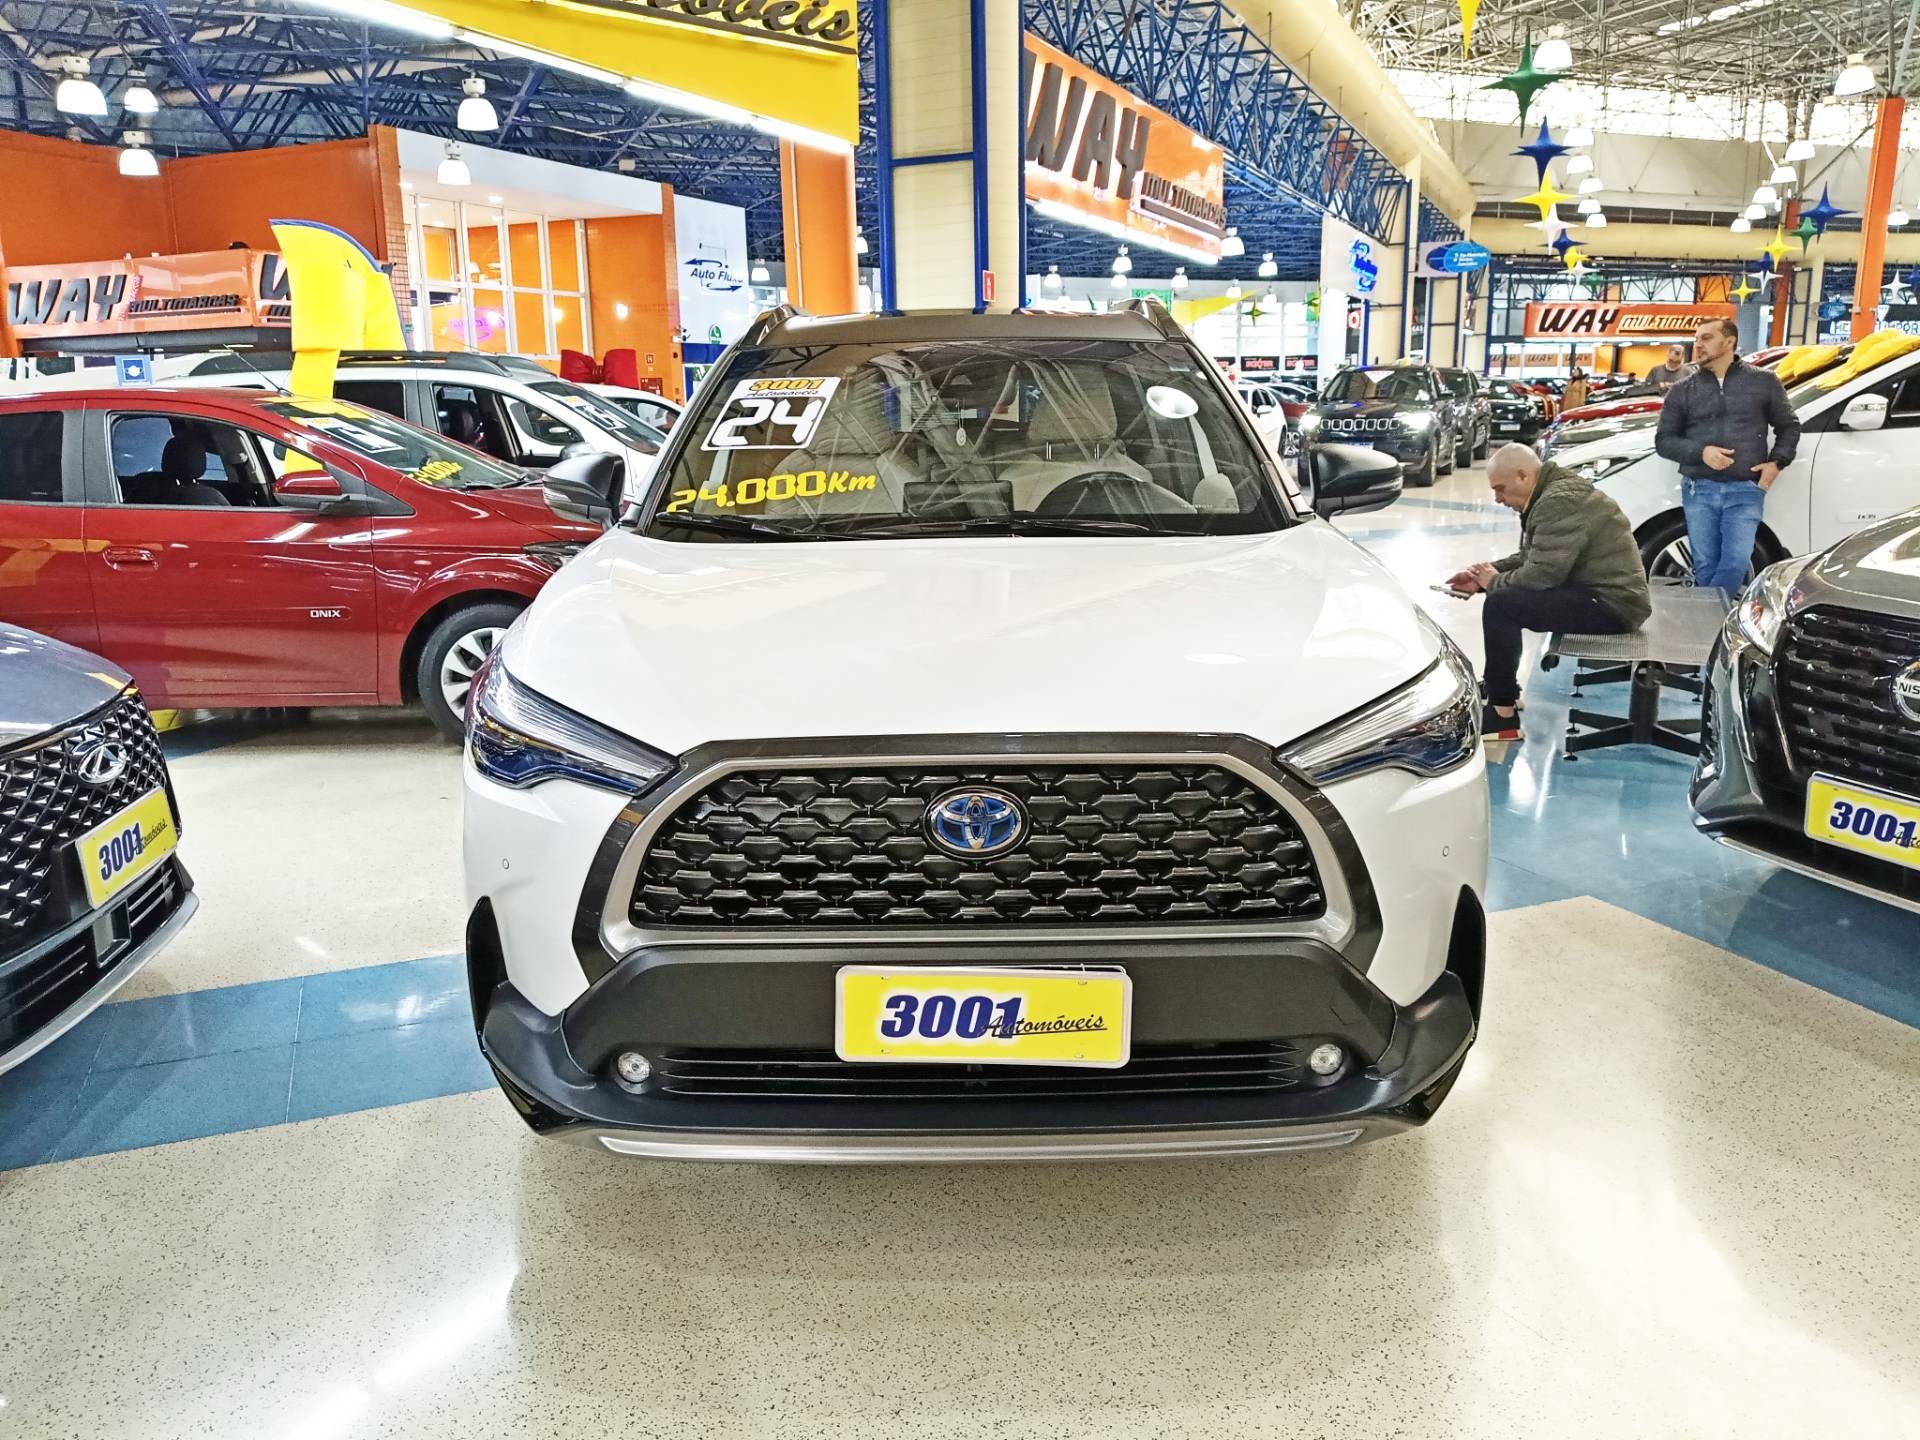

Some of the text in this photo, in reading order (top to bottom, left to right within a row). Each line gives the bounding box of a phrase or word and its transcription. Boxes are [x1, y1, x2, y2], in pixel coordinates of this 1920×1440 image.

[1024, 47, 1228, 230] WAY MULTIMARCAS
[690, 268, 715, 279] Auto
[9, 274, 240, 324] WAY MULTIMARCAS
[1538, 308, 1619, 332] WAY
[749, 379, 824, 391] 3001
[711, 399, 822, 446] 24
[310, 610, 341, 618] ONIX
[1829, 801, 1917, 848] 3001
[99, 822, 144, 881] 3001
[880, 995, 1107, 1039] 3001 Automóveis
